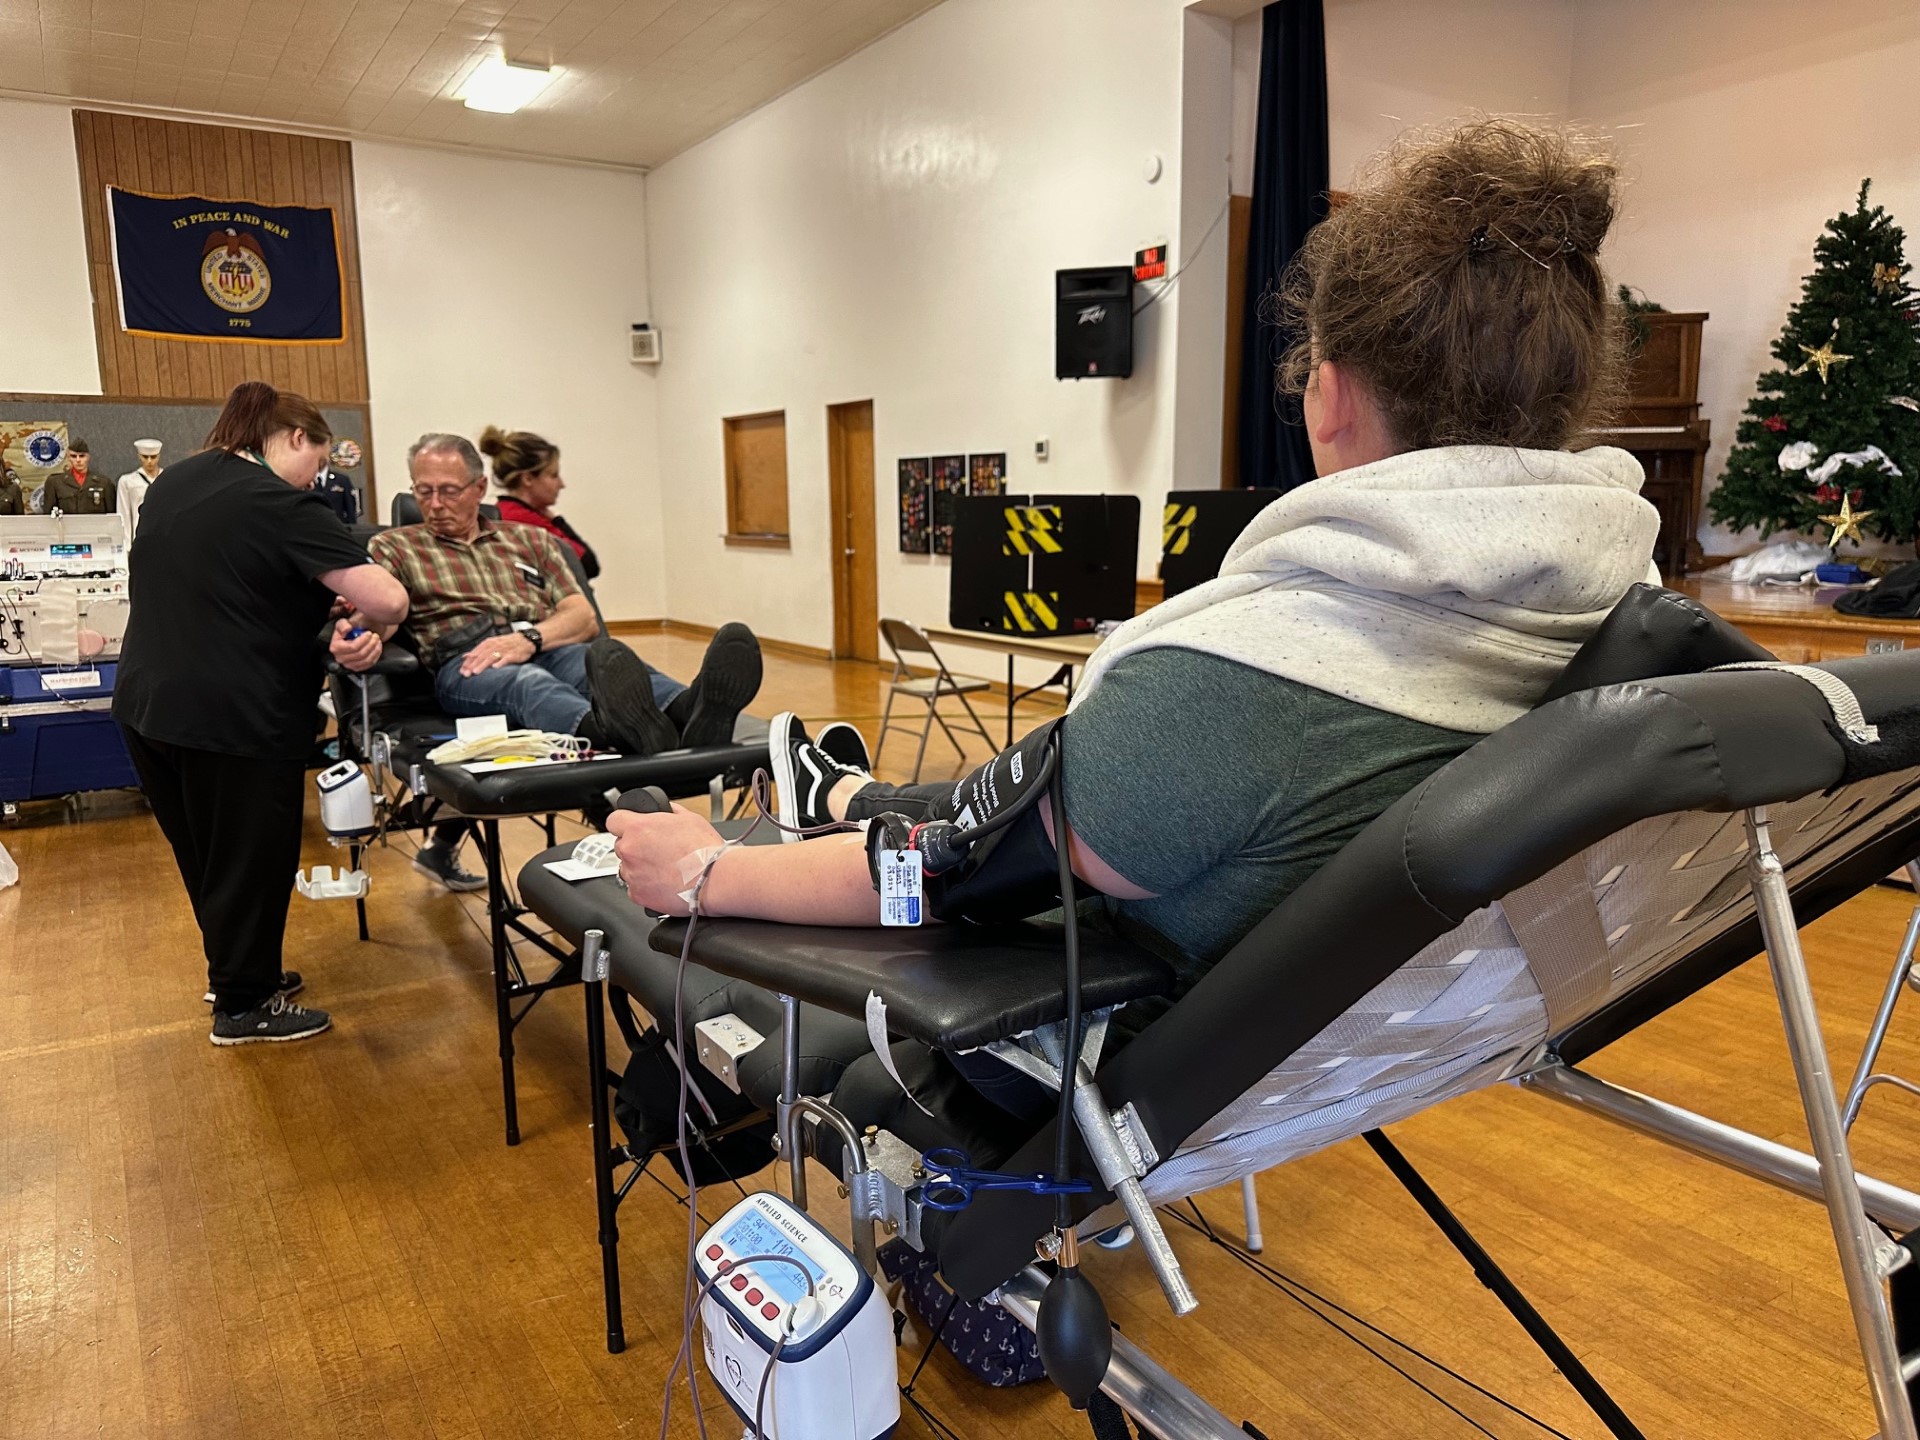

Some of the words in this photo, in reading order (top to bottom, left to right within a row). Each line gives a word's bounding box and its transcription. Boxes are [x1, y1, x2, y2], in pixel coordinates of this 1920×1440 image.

[172, 217, 188, 229] IN
[189, 211, 230, 224] PEACE
[233, 212, 260, 226] AND
[263, 219, 290, 239] WAR
[228, 318, 252, 328] 1775
[1012, 754, 1021, 780] ADULT
[990, 786, 1000, 808] Blood
[755, 1198, 782, 1220] APPLIED
[780, 1219, 808, 1243] SCIENCE
